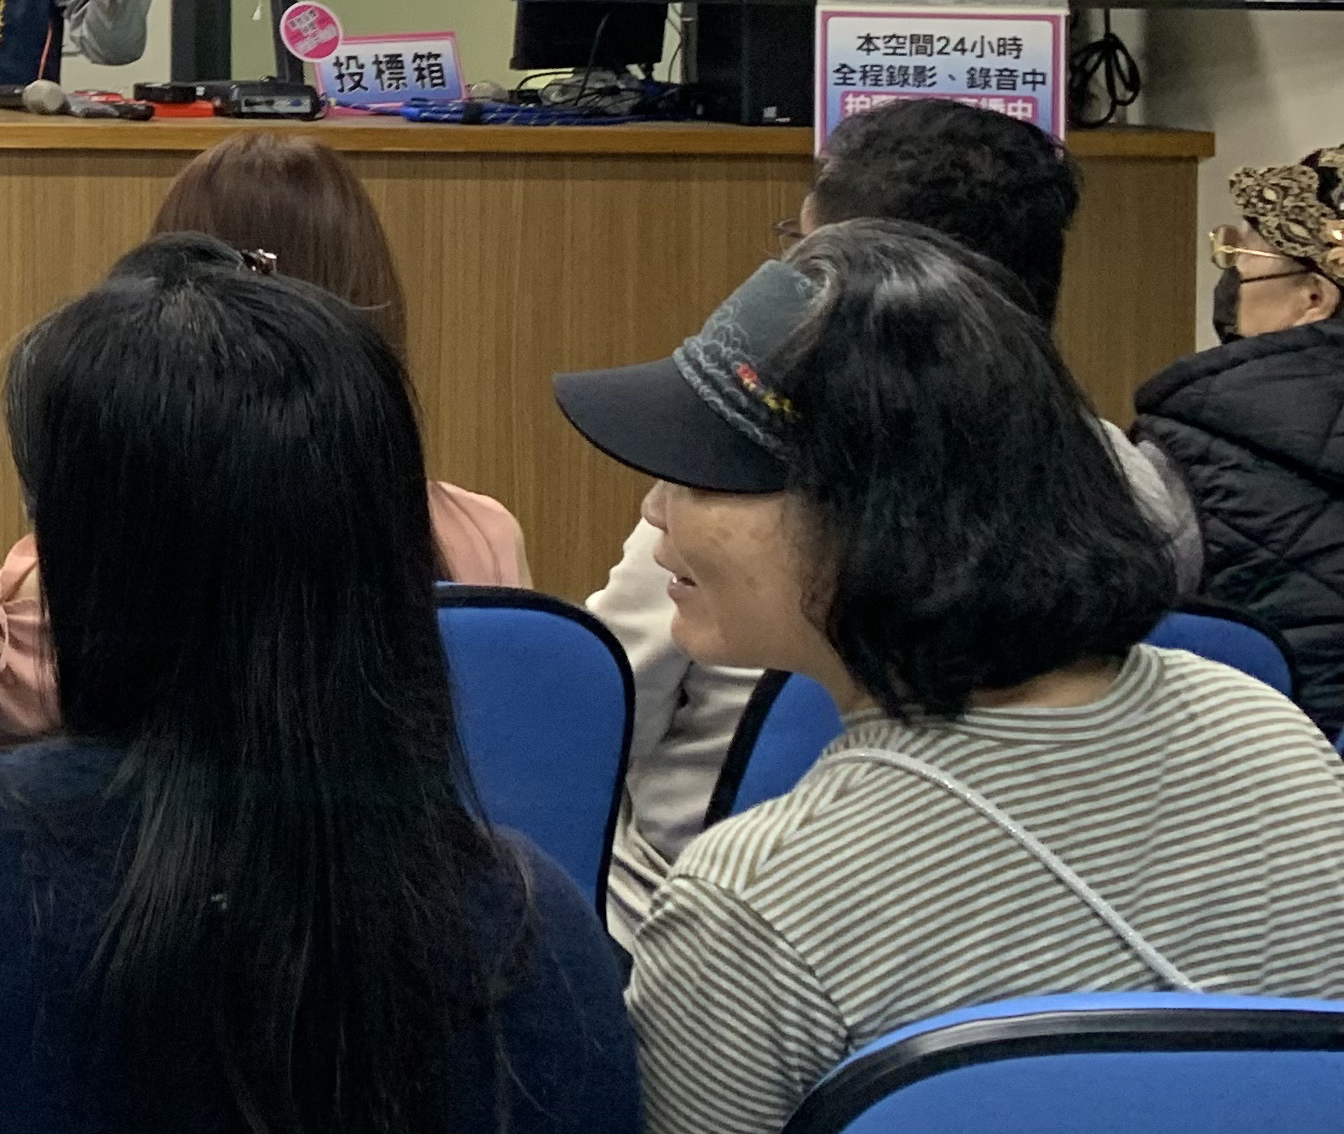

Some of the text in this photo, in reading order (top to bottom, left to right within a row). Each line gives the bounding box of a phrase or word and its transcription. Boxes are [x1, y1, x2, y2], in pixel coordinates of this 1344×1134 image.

[855, 32, 1024, 60] 本空間24小時
[331, 51, 446, 94] 投標箱
[832, 61, 1048, 93] 全程錄影、錄音中
